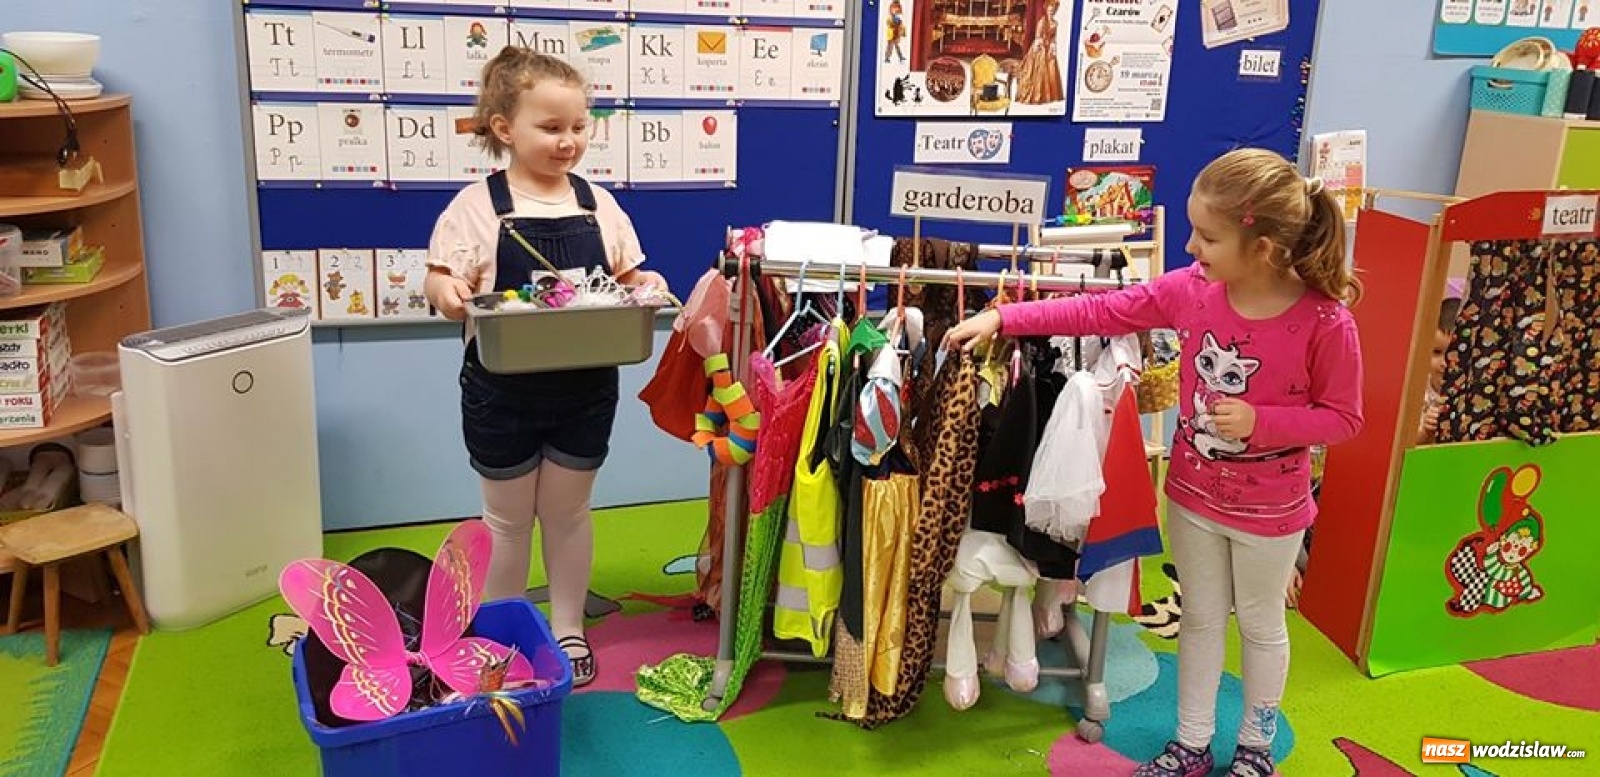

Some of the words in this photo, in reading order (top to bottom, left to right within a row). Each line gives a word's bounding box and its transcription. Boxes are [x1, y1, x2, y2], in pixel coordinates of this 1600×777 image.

[264, 22, 295, 46] Tt
[400, 26, 425, 49] Ll
[516, 31, 565, 55] Mm
[322, 48, 374, 57] termometr
[640, 34, 673, 57] Kk
[753, 38, 779, 59] Ee
[466, 51, 488, 60] lalka
[697, 57, 728, 67] koperta
[1243, 54, 1276, 73] bilet
[267, 113, 303, 144] Pp
[397, 116, 436, 139] Dd
[641, 121, 671, 142] Bb
[338, 137, 368, 147] pralka
[921, 134, 965, 150] Teatr
[1089, 139, 1135, 158] plakat
[902, 186, 1034, 214] garderoba
[1552, 206, 1594, 226] teatr
[272, 257, 279, 269] 1
[331, 255, 339, 267] 2
[387, 255, 395, 268] 3
